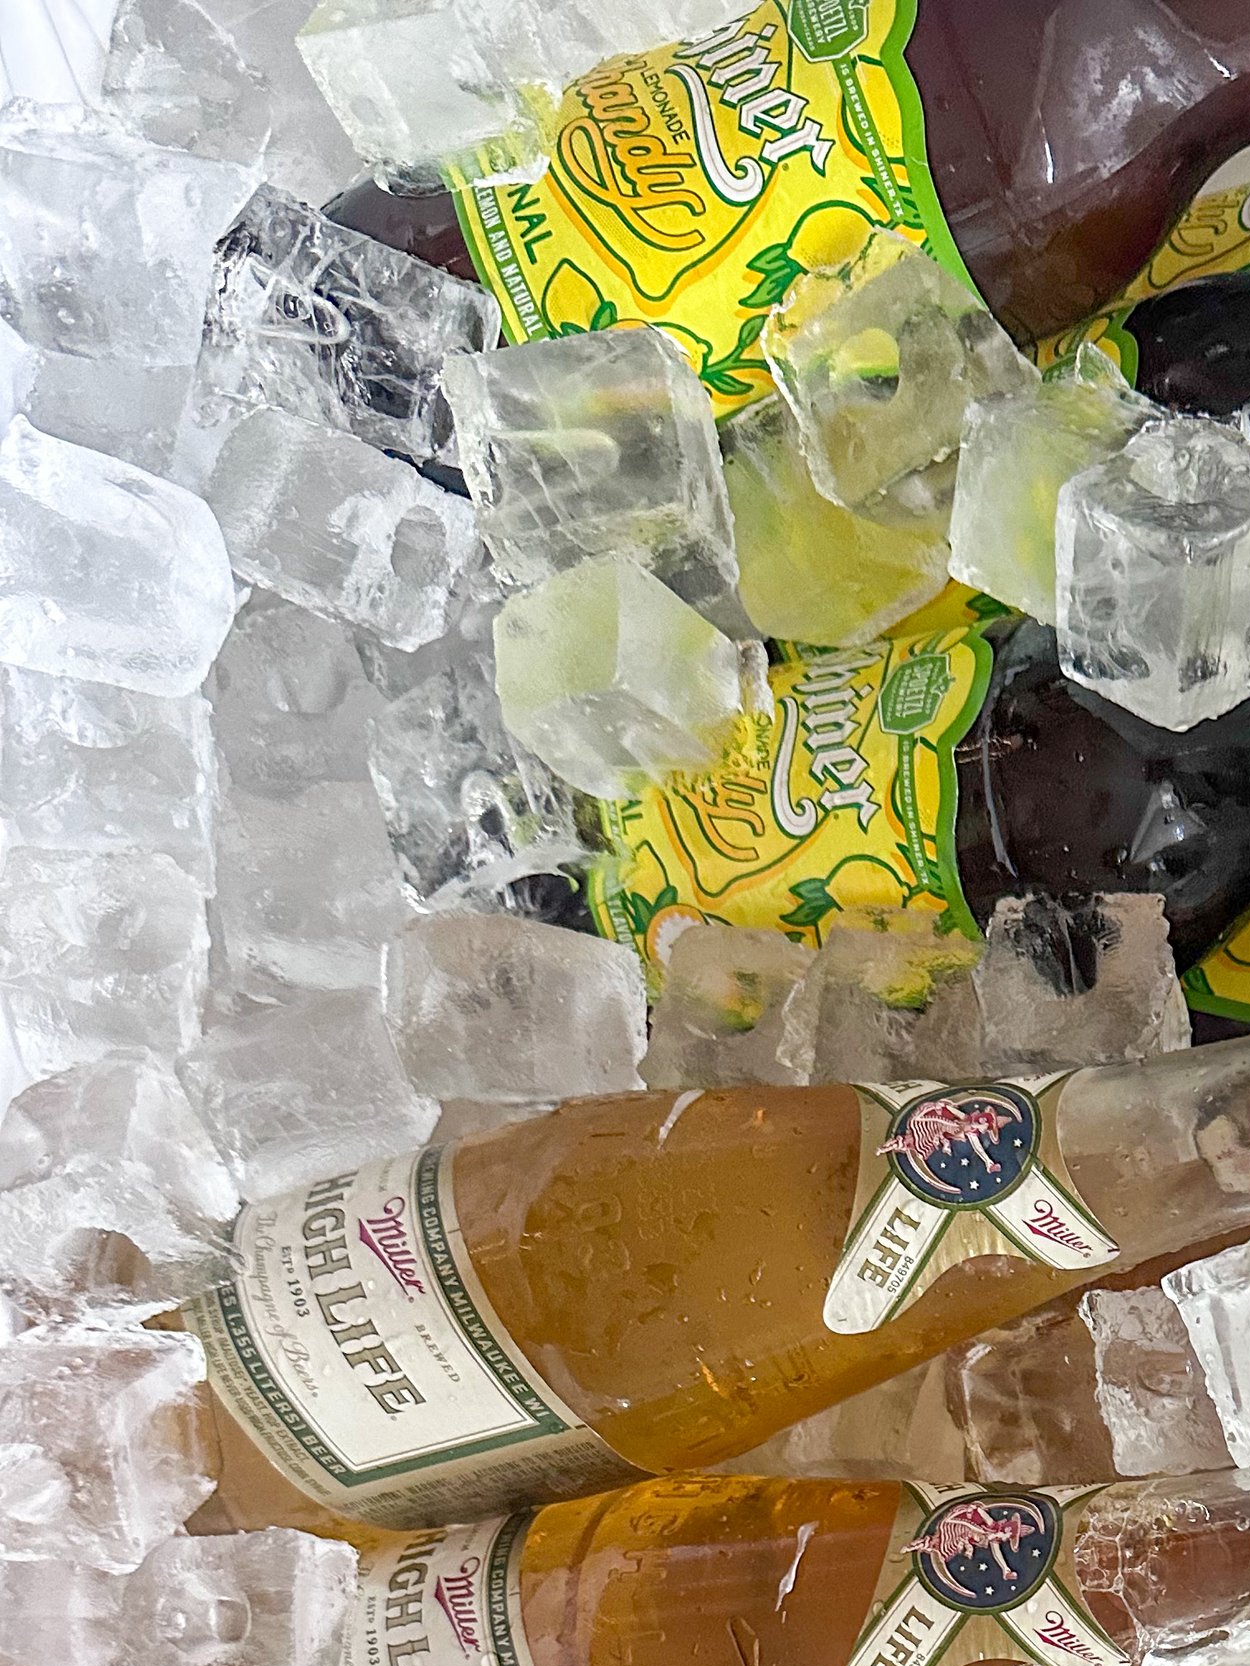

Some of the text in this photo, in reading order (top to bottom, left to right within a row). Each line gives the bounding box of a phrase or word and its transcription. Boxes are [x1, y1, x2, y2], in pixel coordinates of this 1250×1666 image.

[806, 0, 825, 43] REWERY
[819, 0, 848, 43] OETZL
[638, 60, 691, 145] LEMONADE
[664, 18, 836, 208] iner
[840, 64, 849, 76] IS
[845, 79, 868, 130] BREWED
[865, 133, 876, 146] IN
[557, 58, 706, 253] handy
[507, 184, 554, 265] NAL
[488, 231, 513, 260] AND
[501, 265, 544, 342] NATURAL
[778, 643, 885, 840] hiner
[358, 1195, 427, 1299] Miller
[857, 1207, 921, 1289] LIFE
[1022, 1199, 1094, 1257] Miller
[250, 1236, 281, 1322] Champagne
[287, 1279, 312, 1318] 1903
[302, 1168, 427, 1414] HIGH LIFE
[422, 1208, 459, 1288] COMPANY
[450, 1290, 530, 1395] MILWAUKEE
[524, 1395, 552, 1418] WI
[414, 1323, 463, 1384] BREWED
[249, 1361, 302, 1431] LITERS)
[301, 1435, 347, 1475] BEER
[366, 1628, 380, 1666] 1903
[434, 1556, 482, 1658] Miller
[490, 1566, 511, 1648] COMPANY
[1032, 1609, 1101, 1663] Miller
